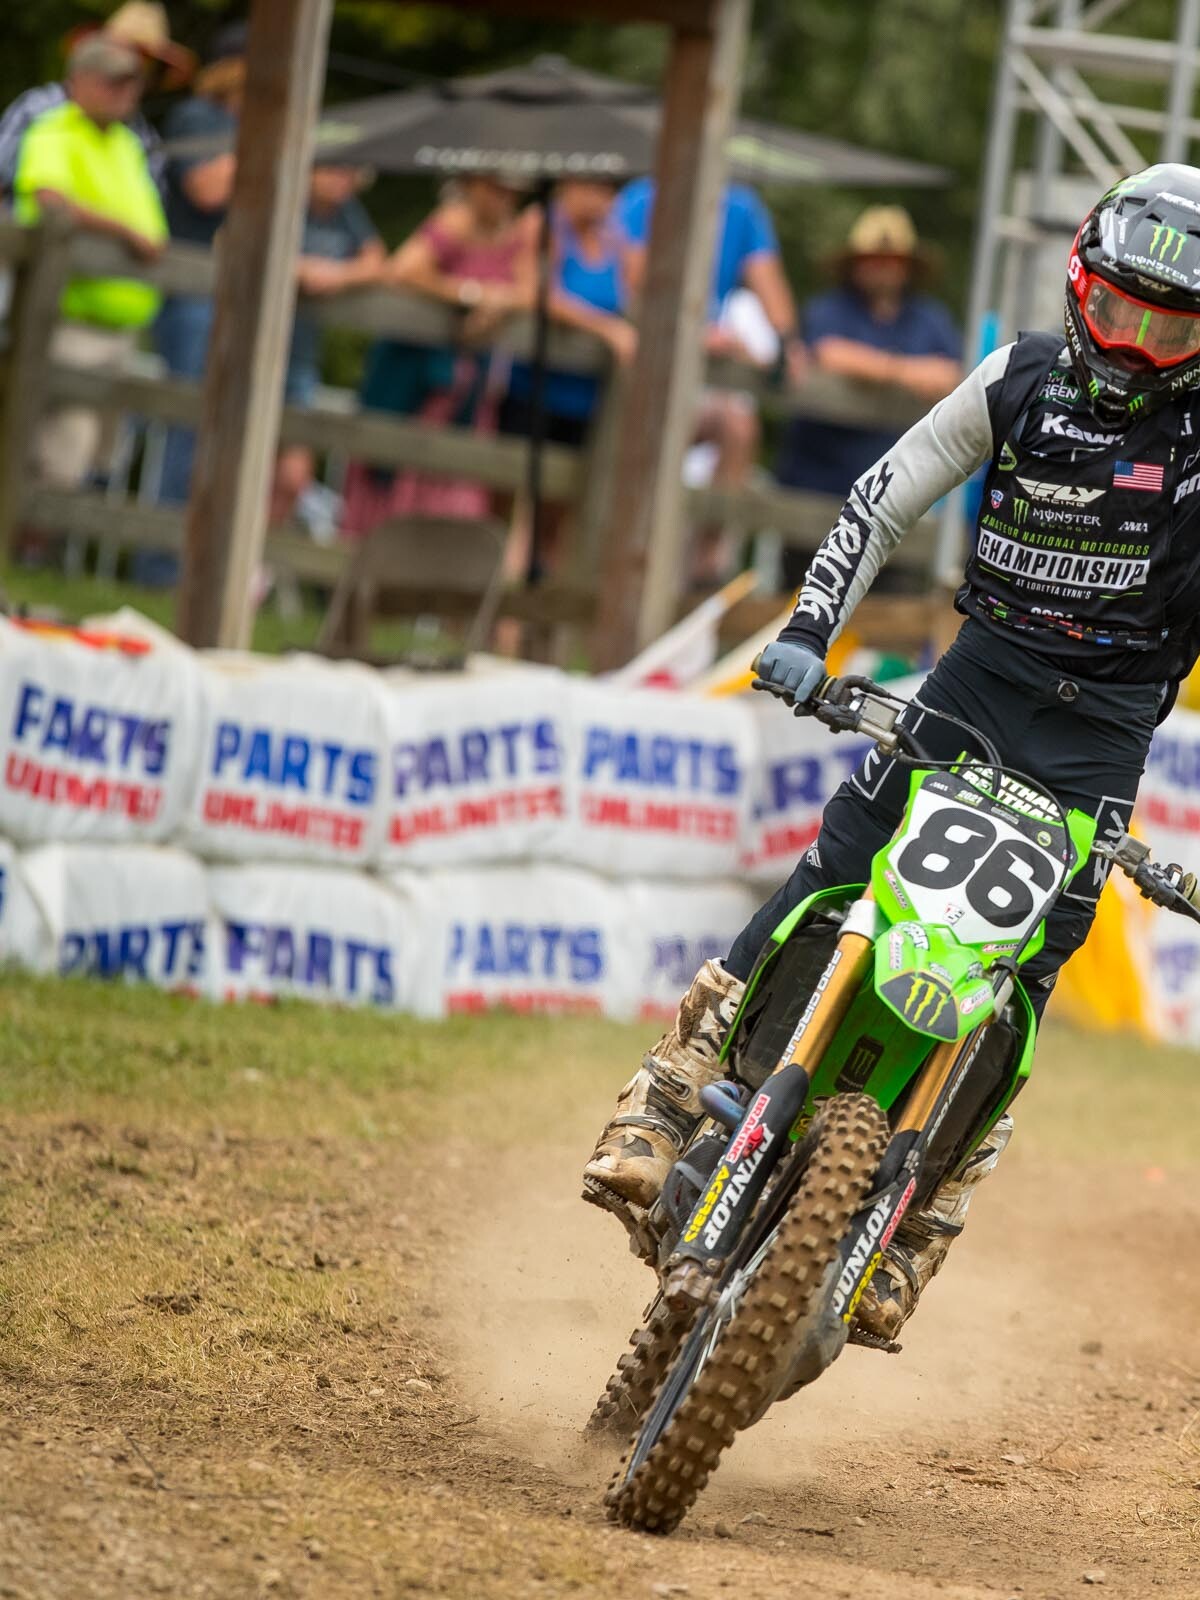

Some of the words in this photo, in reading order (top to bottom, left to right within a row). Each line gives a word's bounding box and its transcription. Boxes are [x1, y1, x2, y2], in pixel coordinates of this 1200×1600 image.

[1124, 253, 1188, 284] MONSTER
[1016, 476, 1107, 504] FLY
[1031, 495, 1086, 508] RACING
[1032, 508, 1101, 527] MONSTER
[979, 533, 1145, 586] CHAMPIONSHIP
[981, 514, 1019, 537] AMATEUR
[1022, 530, 1075, 550] NATIONAL
[1080, 538, 1150, 556] MOTOCROSS
[796, 514, 862, 625] RACING
[1016, 578, 1025, 587] AT
[1026, 581, 1060, 596] LORETTA
[1062, 586, 1092, 600] LYNN'S
[212, 719, 378, 804] PARTS
[392, 717, 561, 798] PARTS
[582, 725, 743, 797] PARTS
[897, 807, 1056, 928] 86
[224, 916, 394, 1005] PARTS
[447, 921, 606, 983] PARTS
[783, 991, 823, 1067] CIRCUIT
[727, 1095, 770, 1163] BRAKING
